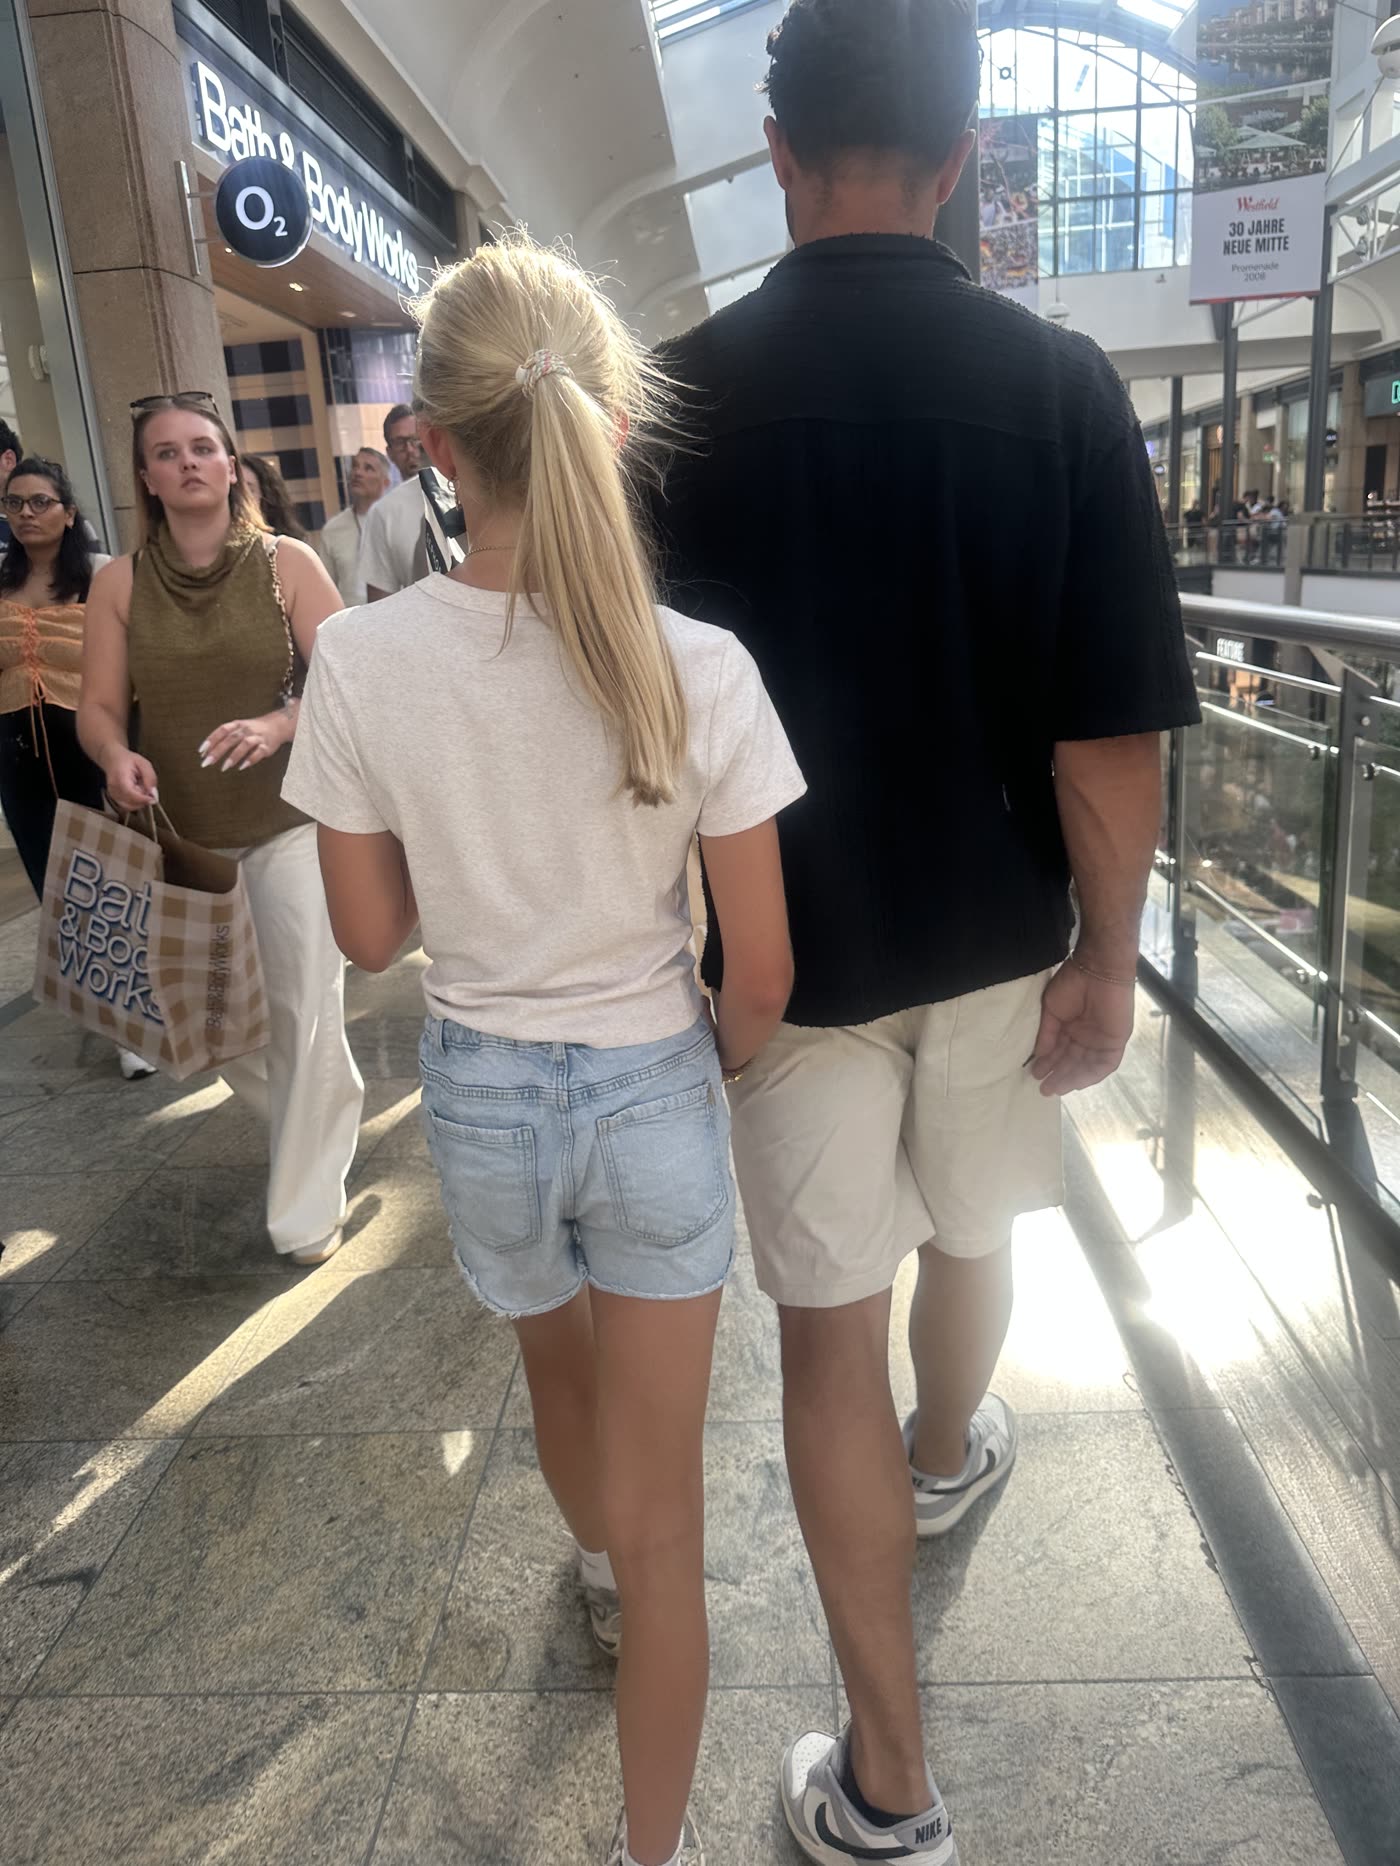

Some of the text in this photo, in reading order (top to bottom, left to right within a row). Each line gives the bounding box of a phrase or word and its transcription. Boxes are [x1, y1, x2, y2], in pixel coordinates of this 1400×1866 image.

[197, 61, 277, 161] Bath
[1237, 196, 1280, 213] Westfield
[1229, 218, 1285, 237] 30 JAHRE
[1223, 235, 1289, 255] NEUE MITTE
[1231, 261, 1280, 272] Promenade
[58, 903, 81, 942] &
[915, 1817, 942, 1844] NIKE
